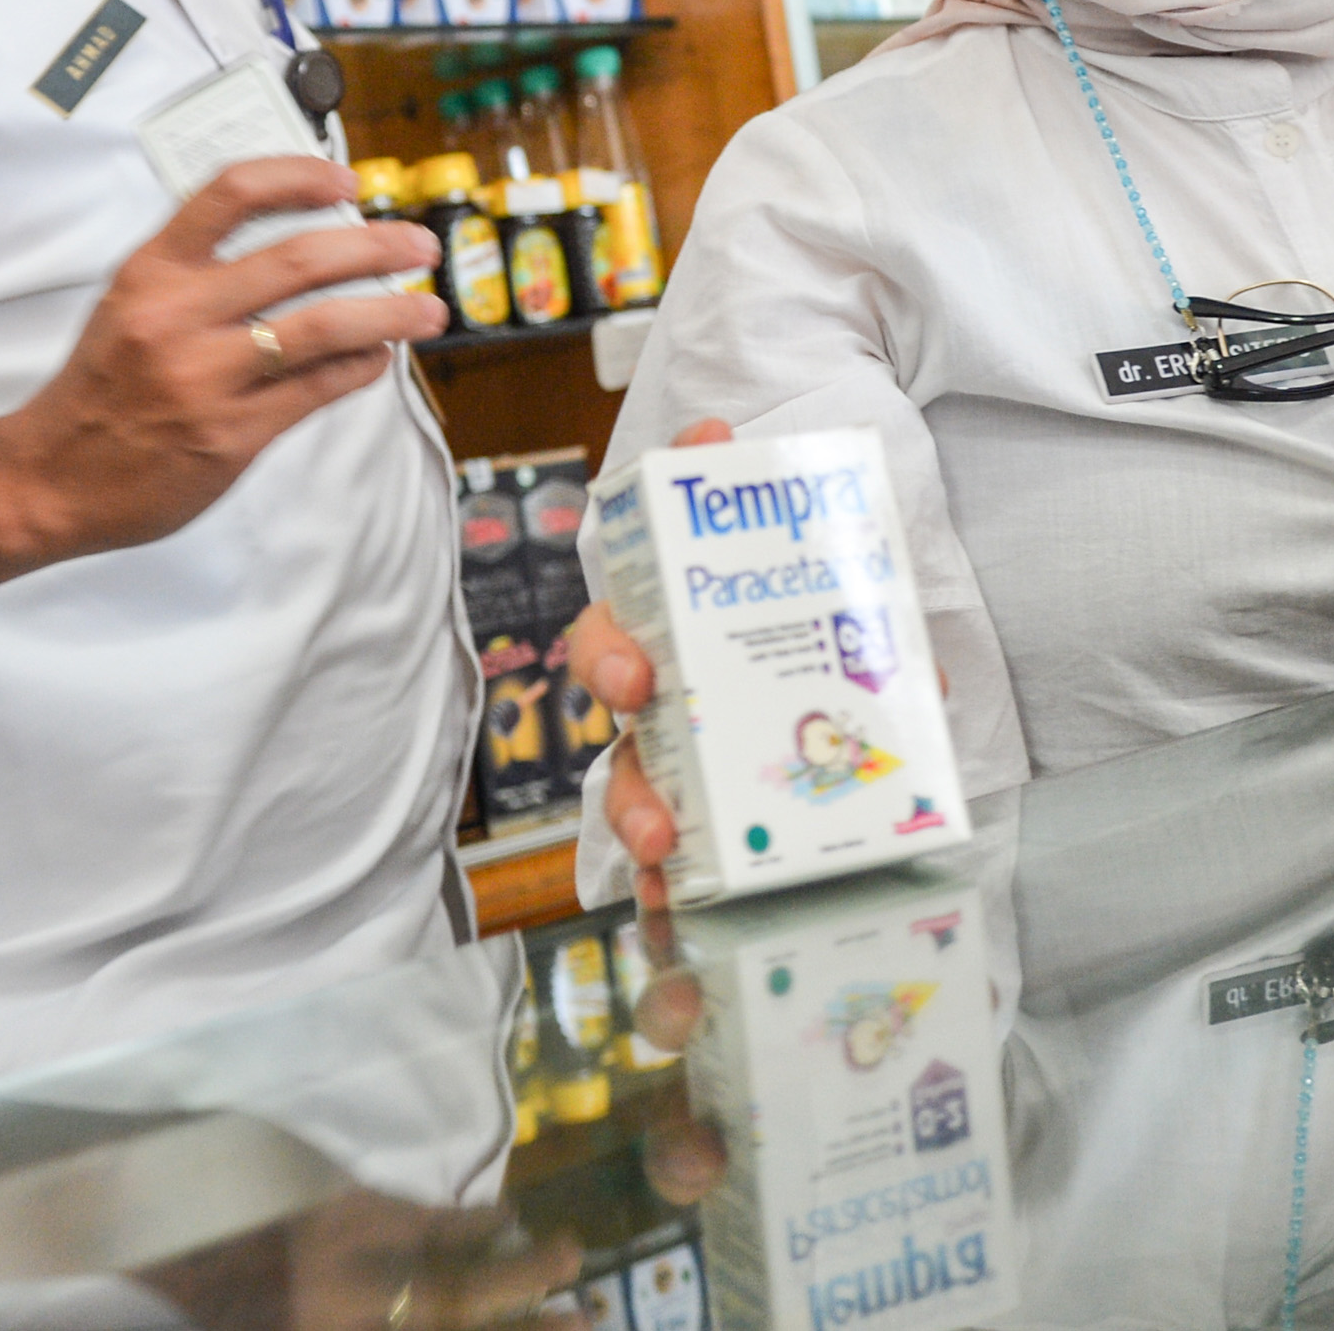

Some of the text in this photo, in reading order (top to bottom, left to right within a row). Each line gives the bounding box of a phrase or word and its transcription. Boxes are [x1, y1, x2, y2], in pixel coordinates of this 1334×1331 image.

[1118, 360, 1152, 384] dr.
[671, 466, 869, 543] Tempra
[684, 538, 896, 612] Paracetaol
